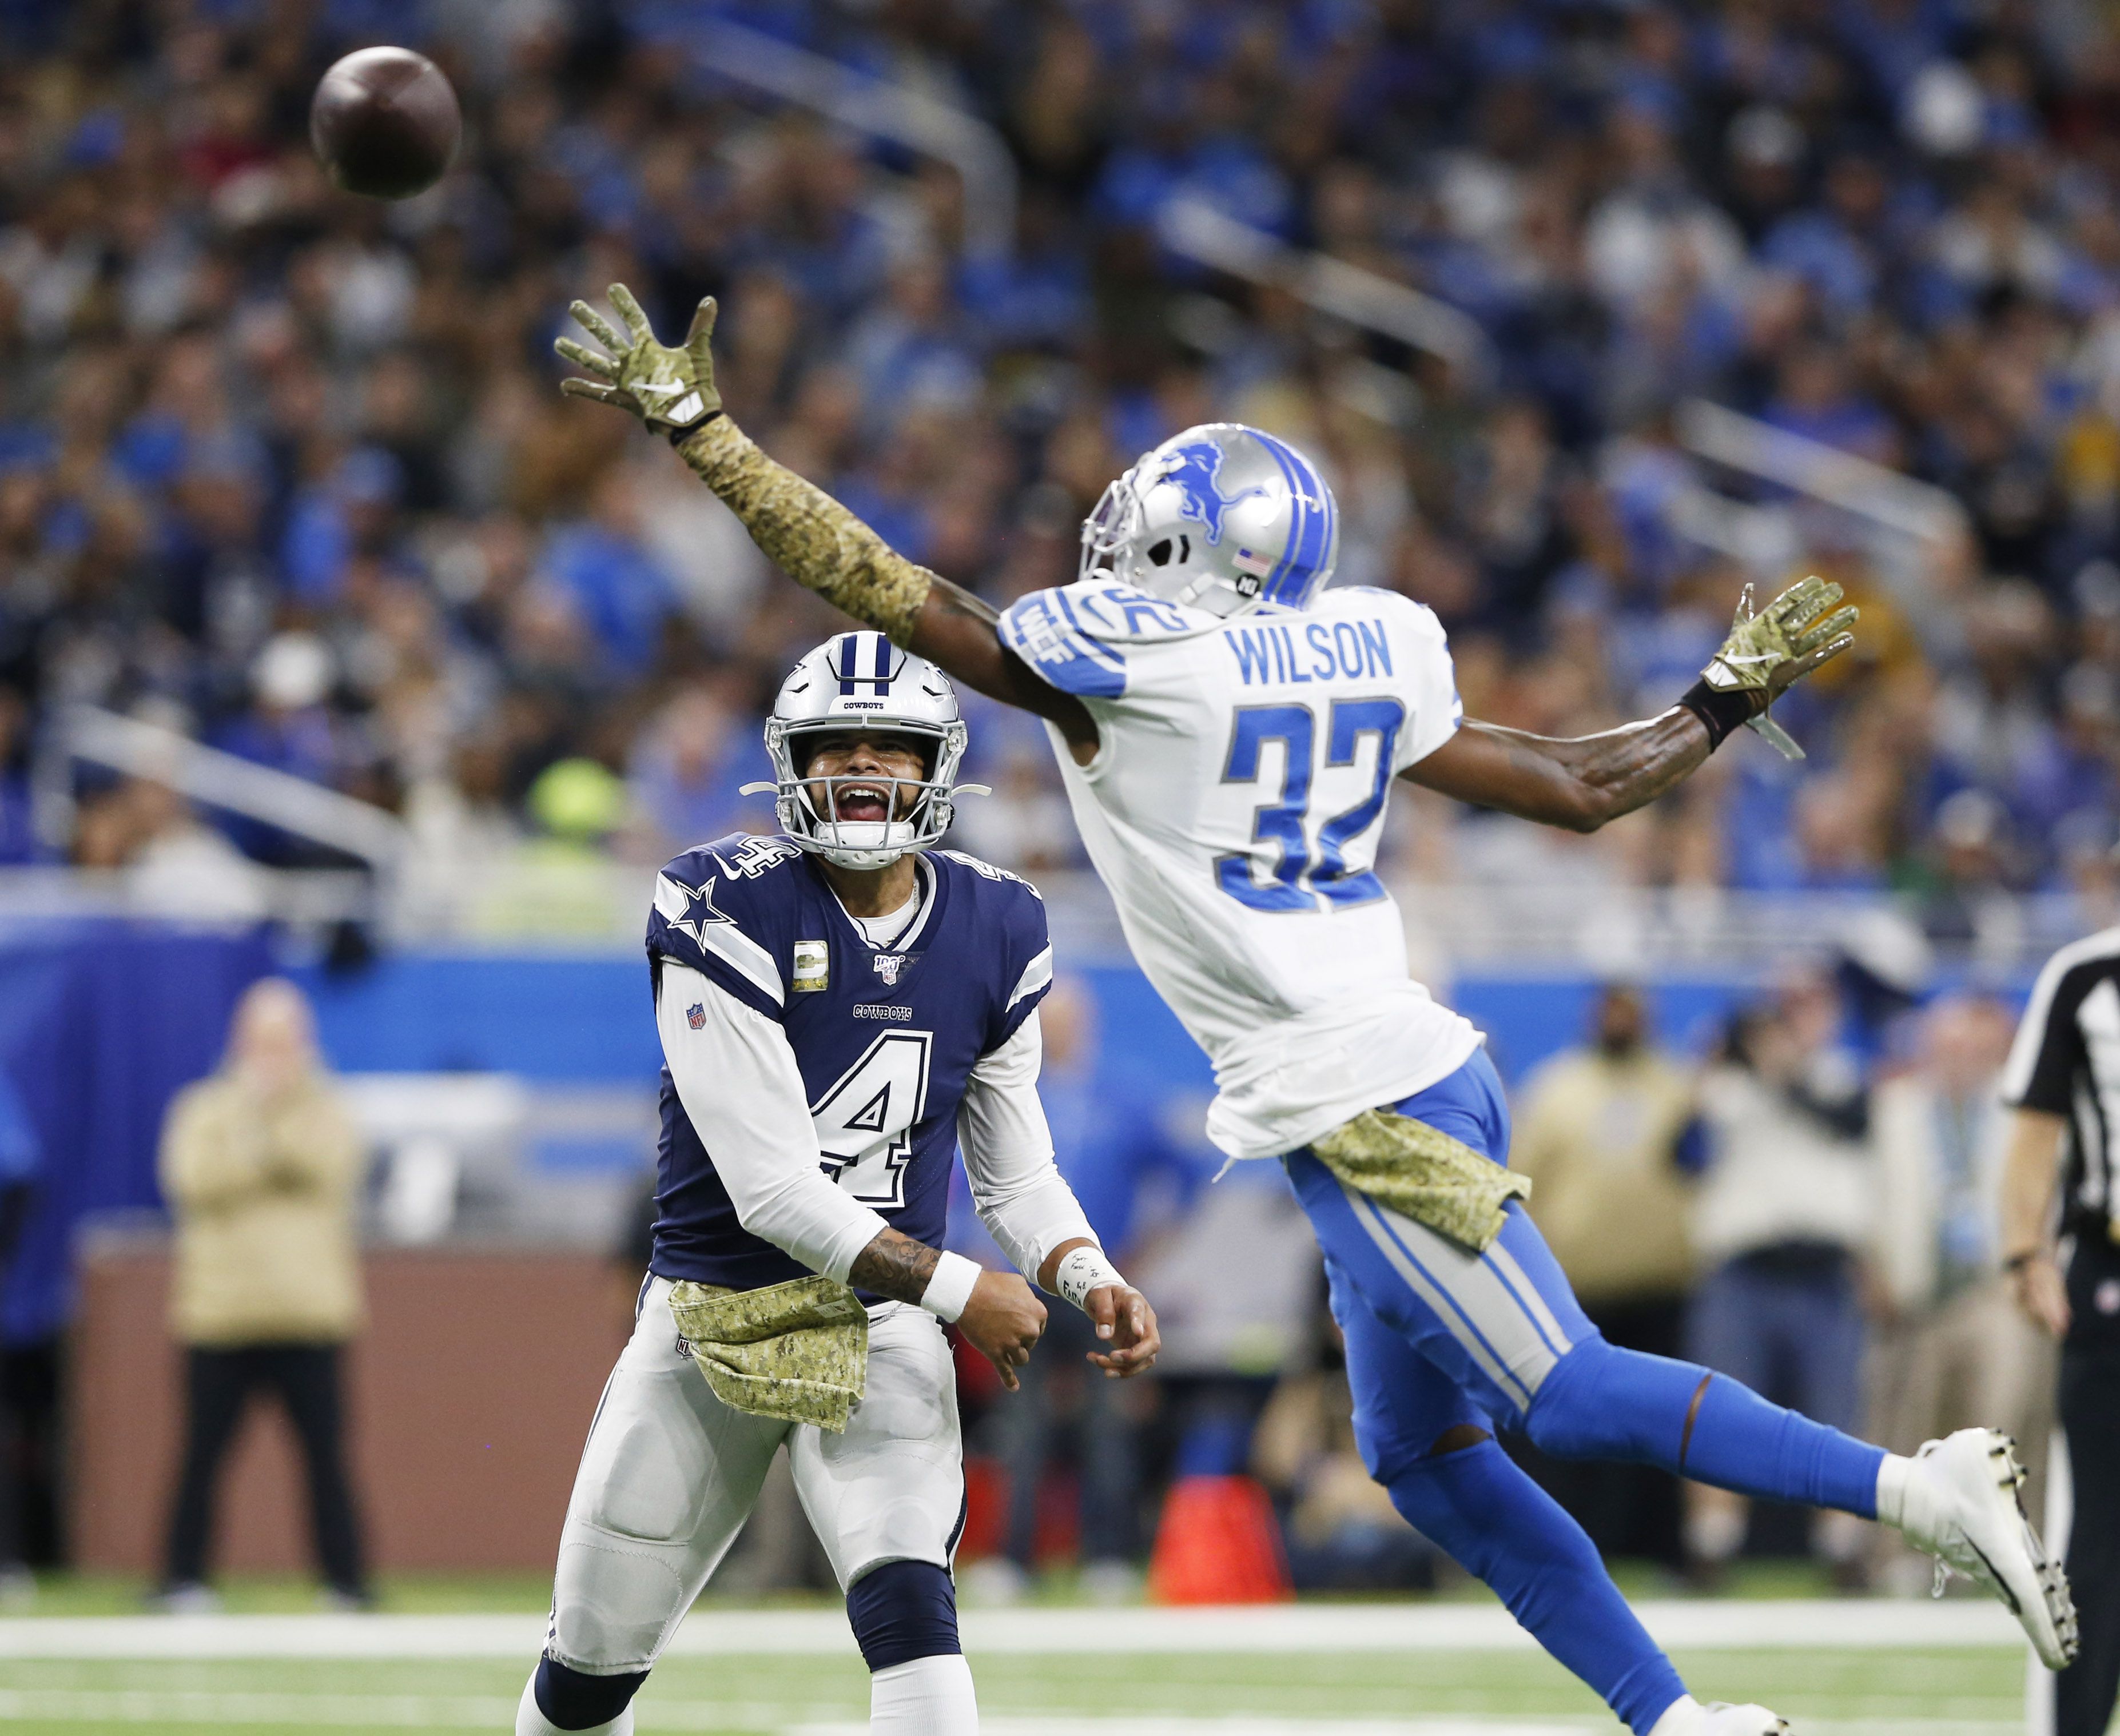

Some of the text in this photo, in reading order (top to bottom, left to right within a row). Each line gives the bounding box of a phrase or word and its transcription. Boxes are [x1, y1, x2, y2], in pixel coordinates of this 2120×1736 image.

[1224, 619, 1393, 685] WILSON
[844, 702, 884, 710] COWBOYS
[1212, 695, 1407, 914] 32
[793, 944, 827, 979] C
[690, 1013, 706, 1028] NFL
[853, 1004, 913, 1021] COWBOYS
[809, 1028, 934, 1208] 4
